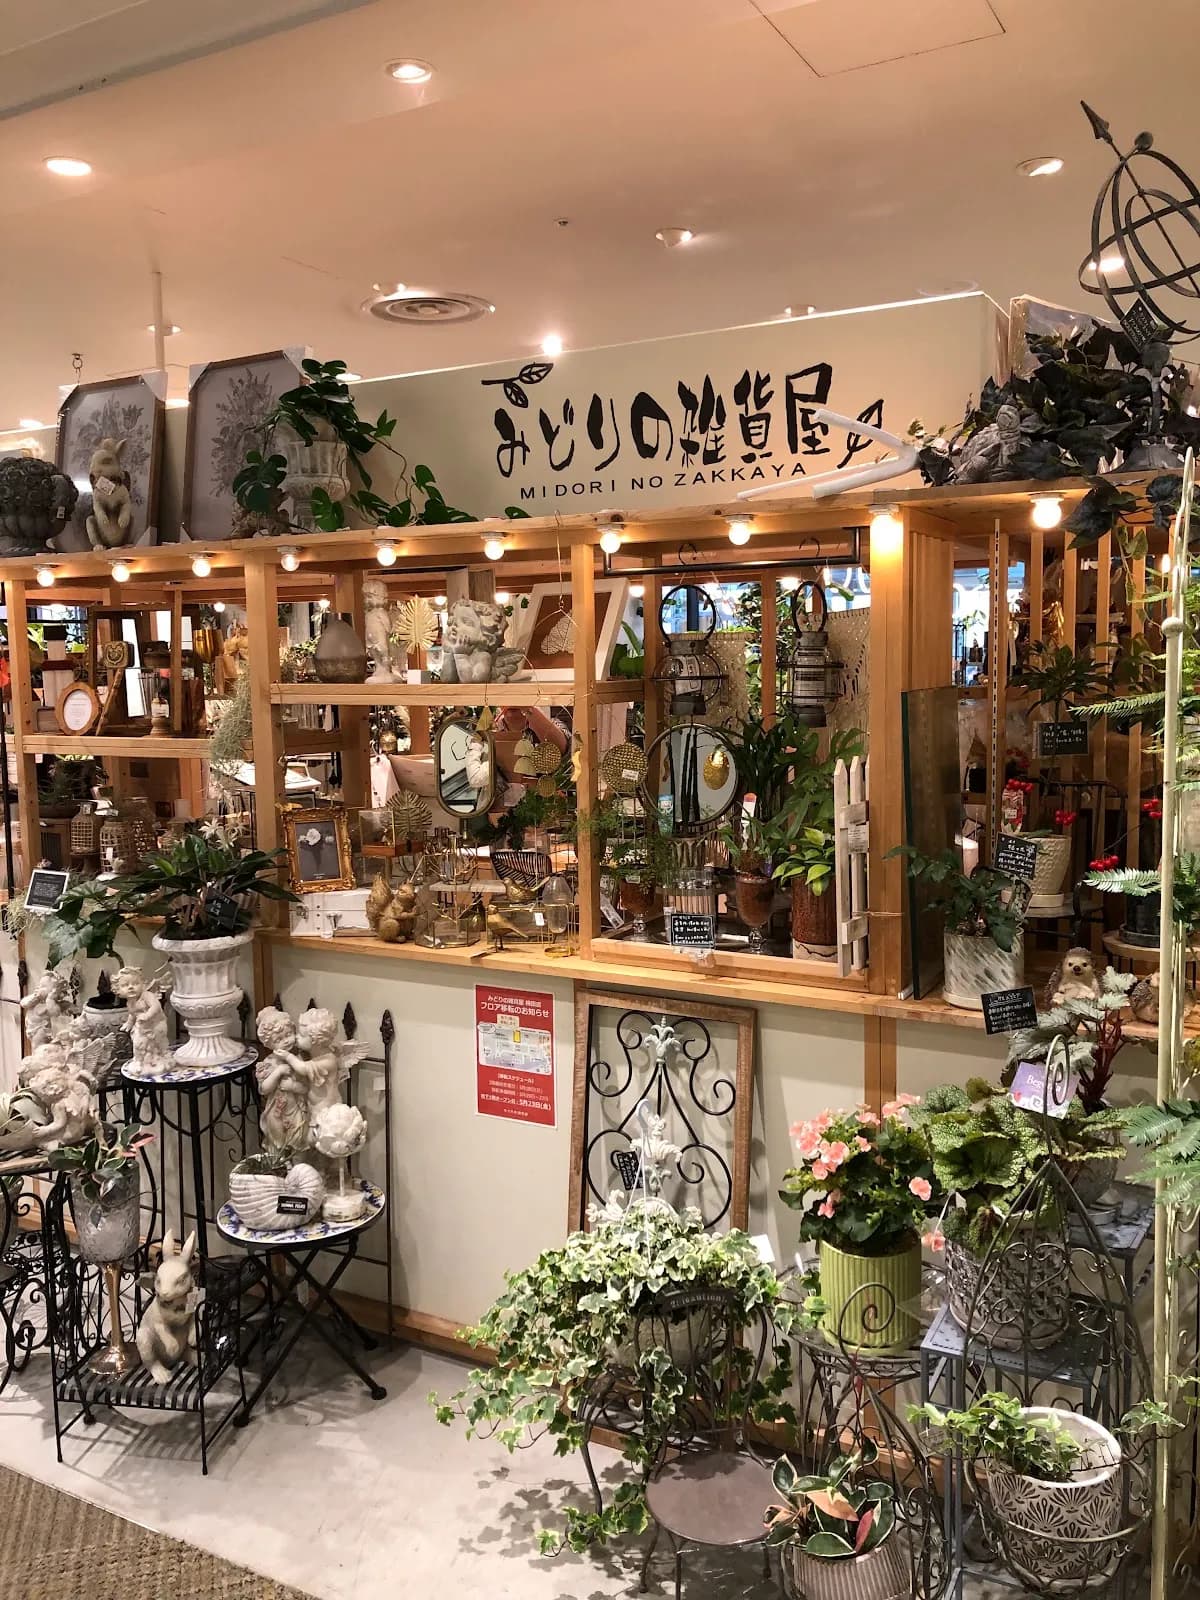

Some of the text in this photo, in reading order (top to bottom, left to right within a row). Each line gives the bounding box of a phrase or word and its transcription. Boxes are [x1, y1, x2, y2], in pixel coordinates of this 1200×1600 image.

[482, 362, 833, 478] みどりの雑貨屋
[520, 462, 807, 500] MIDORI NO ZAKKAYA
[480, 1001, 550, 1018] フロア移転のお知らせ
